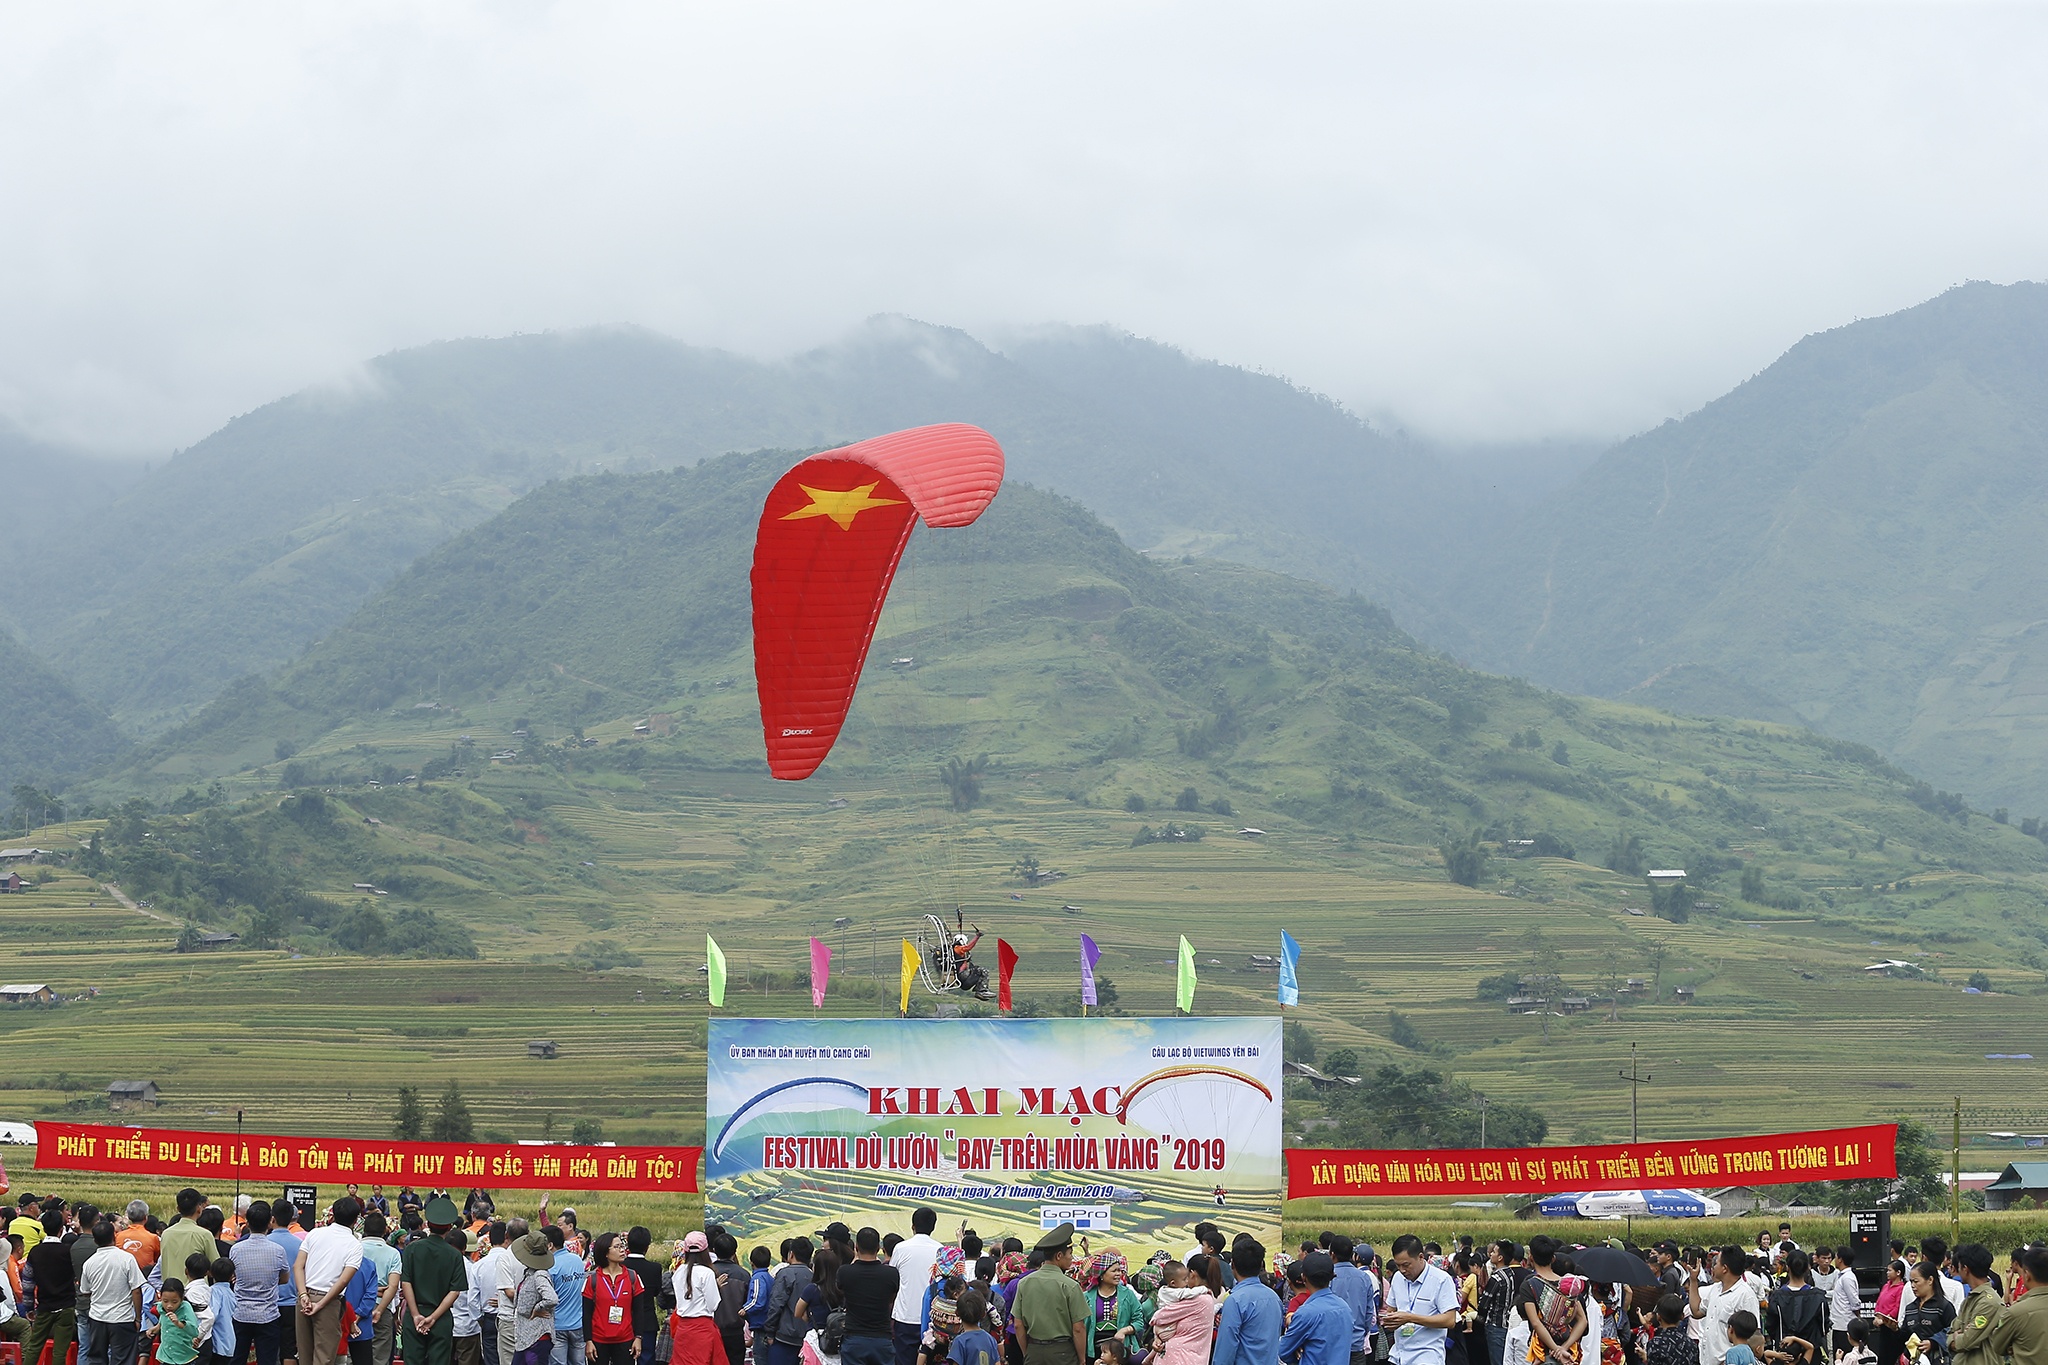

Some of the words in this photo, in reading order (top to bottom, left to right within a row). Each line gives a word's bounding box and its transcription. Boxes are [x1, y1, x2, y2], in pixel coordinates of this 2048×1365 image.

[742, 1048, 755, 1058] BAN
[758, 1046, 777, 1058] NHÂN
[779, 1046, 793, 1058] DÂN
[795, 1046, 817, 1060] HUYỆN
[833, 1048, 852, 1058] CANG
[1152, 1046, 1166, 1057] CÂU
[1168, 1048, 1180, 1060] LẠC
[1182, 1046, 1192, 1060] BỘ
[1193, 1047, 1231, 1057] VIETWINGS
[1232, 1045, 1246, 1057] YÊN
[866, 1086, 1002, 1116] KHAI
[1016, 1086, 1122, 1126] MẠC
[57, 1133, 97, 1157] PHÁT
[105, 1131, 151, 1160] TRIỂN
[185, 1143, 222, 1168] LỊCH
[230, 1142, 250, 1166] LÀ
[259, 1141, 289, 1168] BẢO
[298, 1143, 329, 1170] TỒN
[337, 1147, 354, 1171] VÀ
[364, 1149, 405, 1174] PHÁT
[413, 1155, 445, 1174] HUY
[454, 1150, 486, 1176] BẢN
[492, 1150, 523, 1176] SẮC
[533, 1154, 561, 1178] VĂN
[569, 1153, 599, 1178] HÓA
[607, 1154, 637, 1179] DÂN
[764, 1137, 849, 1169] FESTIVAL
[856, 1133, 882, 1169] DÙ
[889, 1133, 939, 1175] LƯỢN
[1000, 1133, 1048, 1170] TRÊN
[1055, 1132, 1099, 1170] MÙA
[1173, 1138, 1226, 1170] 2019
[1311, 1159, 1337, 1185] XÂY
[1343, 1161, 1381, 1189] DỰNG
[1385, 1160, 1411, 1183] VĂN
[1414, 1158, 1443, 1183] HÓA
[1446, 1162, 1466, 1182] DU
[1471, 1161, 1503, 1186] LỊCH
[1507, 1157, 1523, 1181] VÌ
[1527, 1158, 1547, 1186] SỰ
[1552, 1154, 1590, 1181] PHÁT
[1596, 1151, 1641, 1180] TRIỂN
[1644, 1150, 1675, 1177] BỀN
[1679, 1148, 1719, 1175] VỮNG
[1723, 1150, 1773, 1174] TRONG
[1777, 1144, 1828, 1170] TƯƠNG
[1834, 1143, 1859, 1167] LAI
[877, 1184, 895, 1197] Mù
[897, 1185, 927, 1198] Cang
[961, 1185, 991, 1199] ngày
[993, 1185, 1007, 1197] 21
[1009, 1185, 1043, 1199] tháng
[1045, 1185, 1054, 1197] 9
[1056, 1185, 1081, 1197] năm
[1083, 1185, 1114, 1197] 2019
[1043, 1209, 1108, 1219] GoPro
